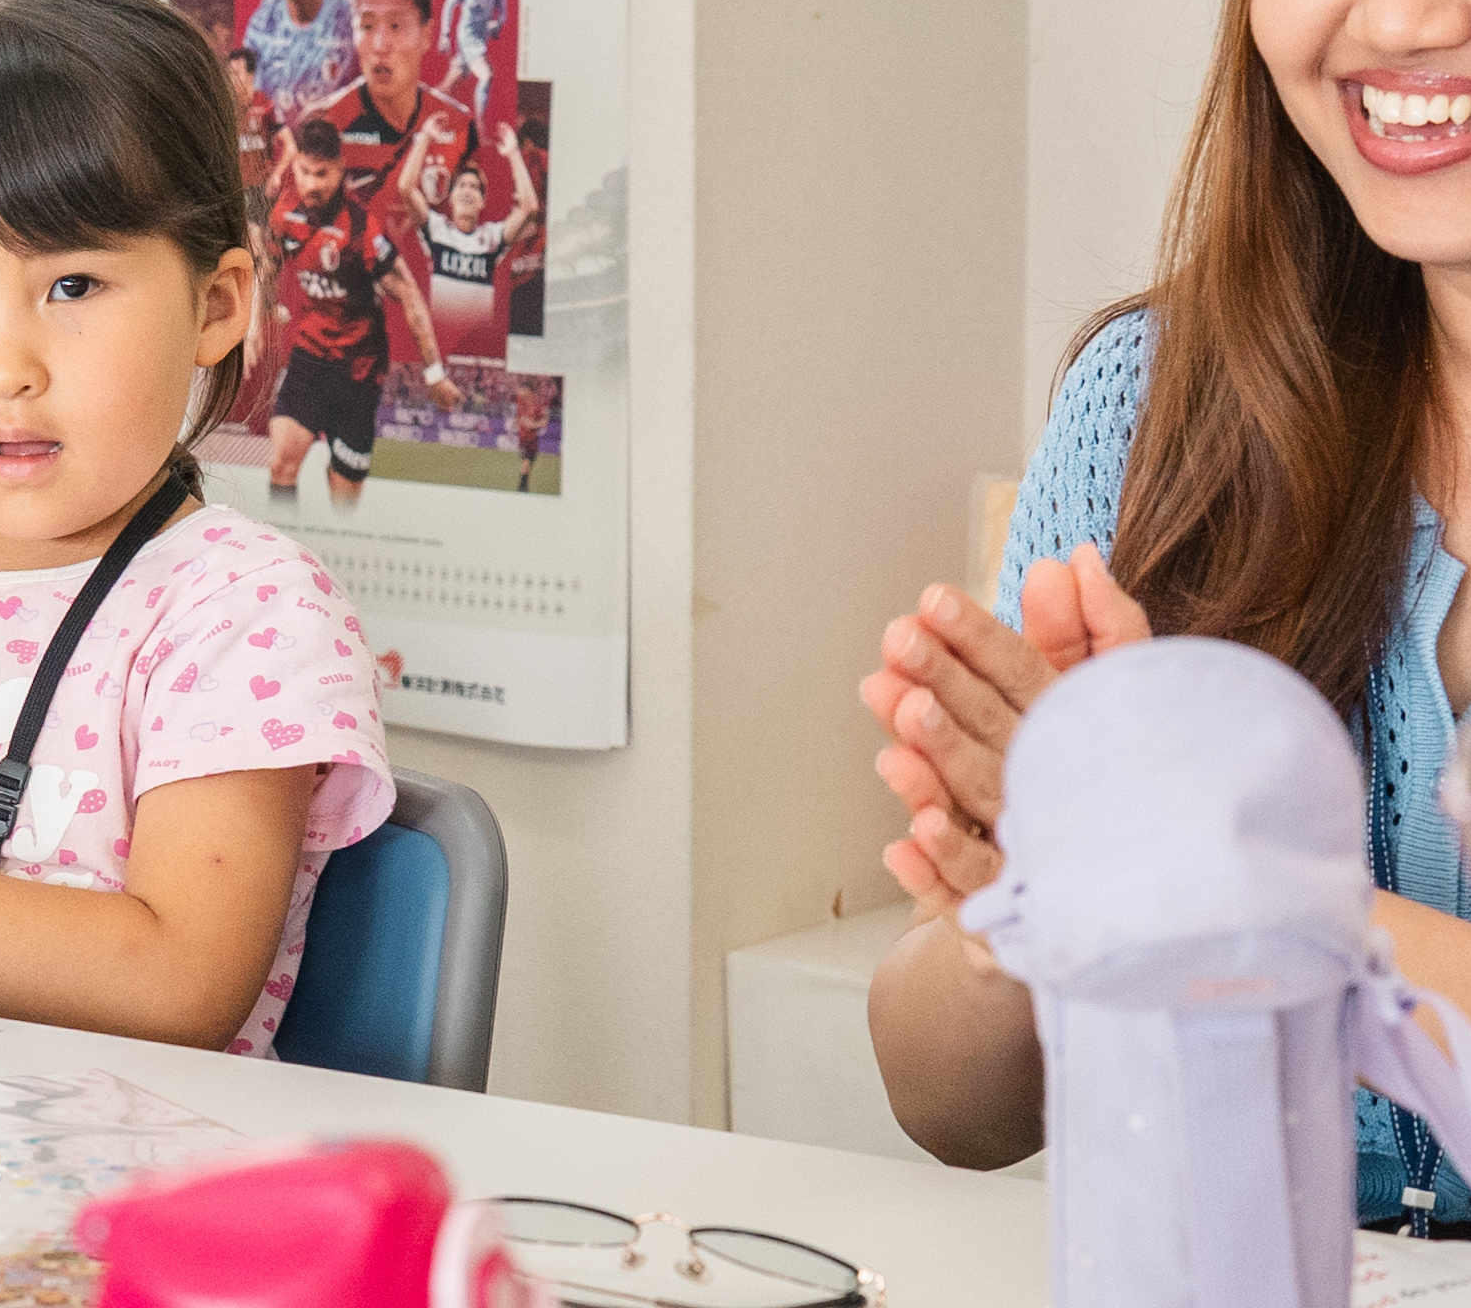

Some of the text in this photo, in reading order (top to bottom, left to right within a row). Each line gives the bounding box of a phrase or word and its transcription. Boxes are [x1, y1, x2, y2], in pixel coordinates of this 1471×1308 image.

[296, 596, 331, 619] Love
[318, 672, 354, 686] Ollin
[148, 759, 181, 771] Love
